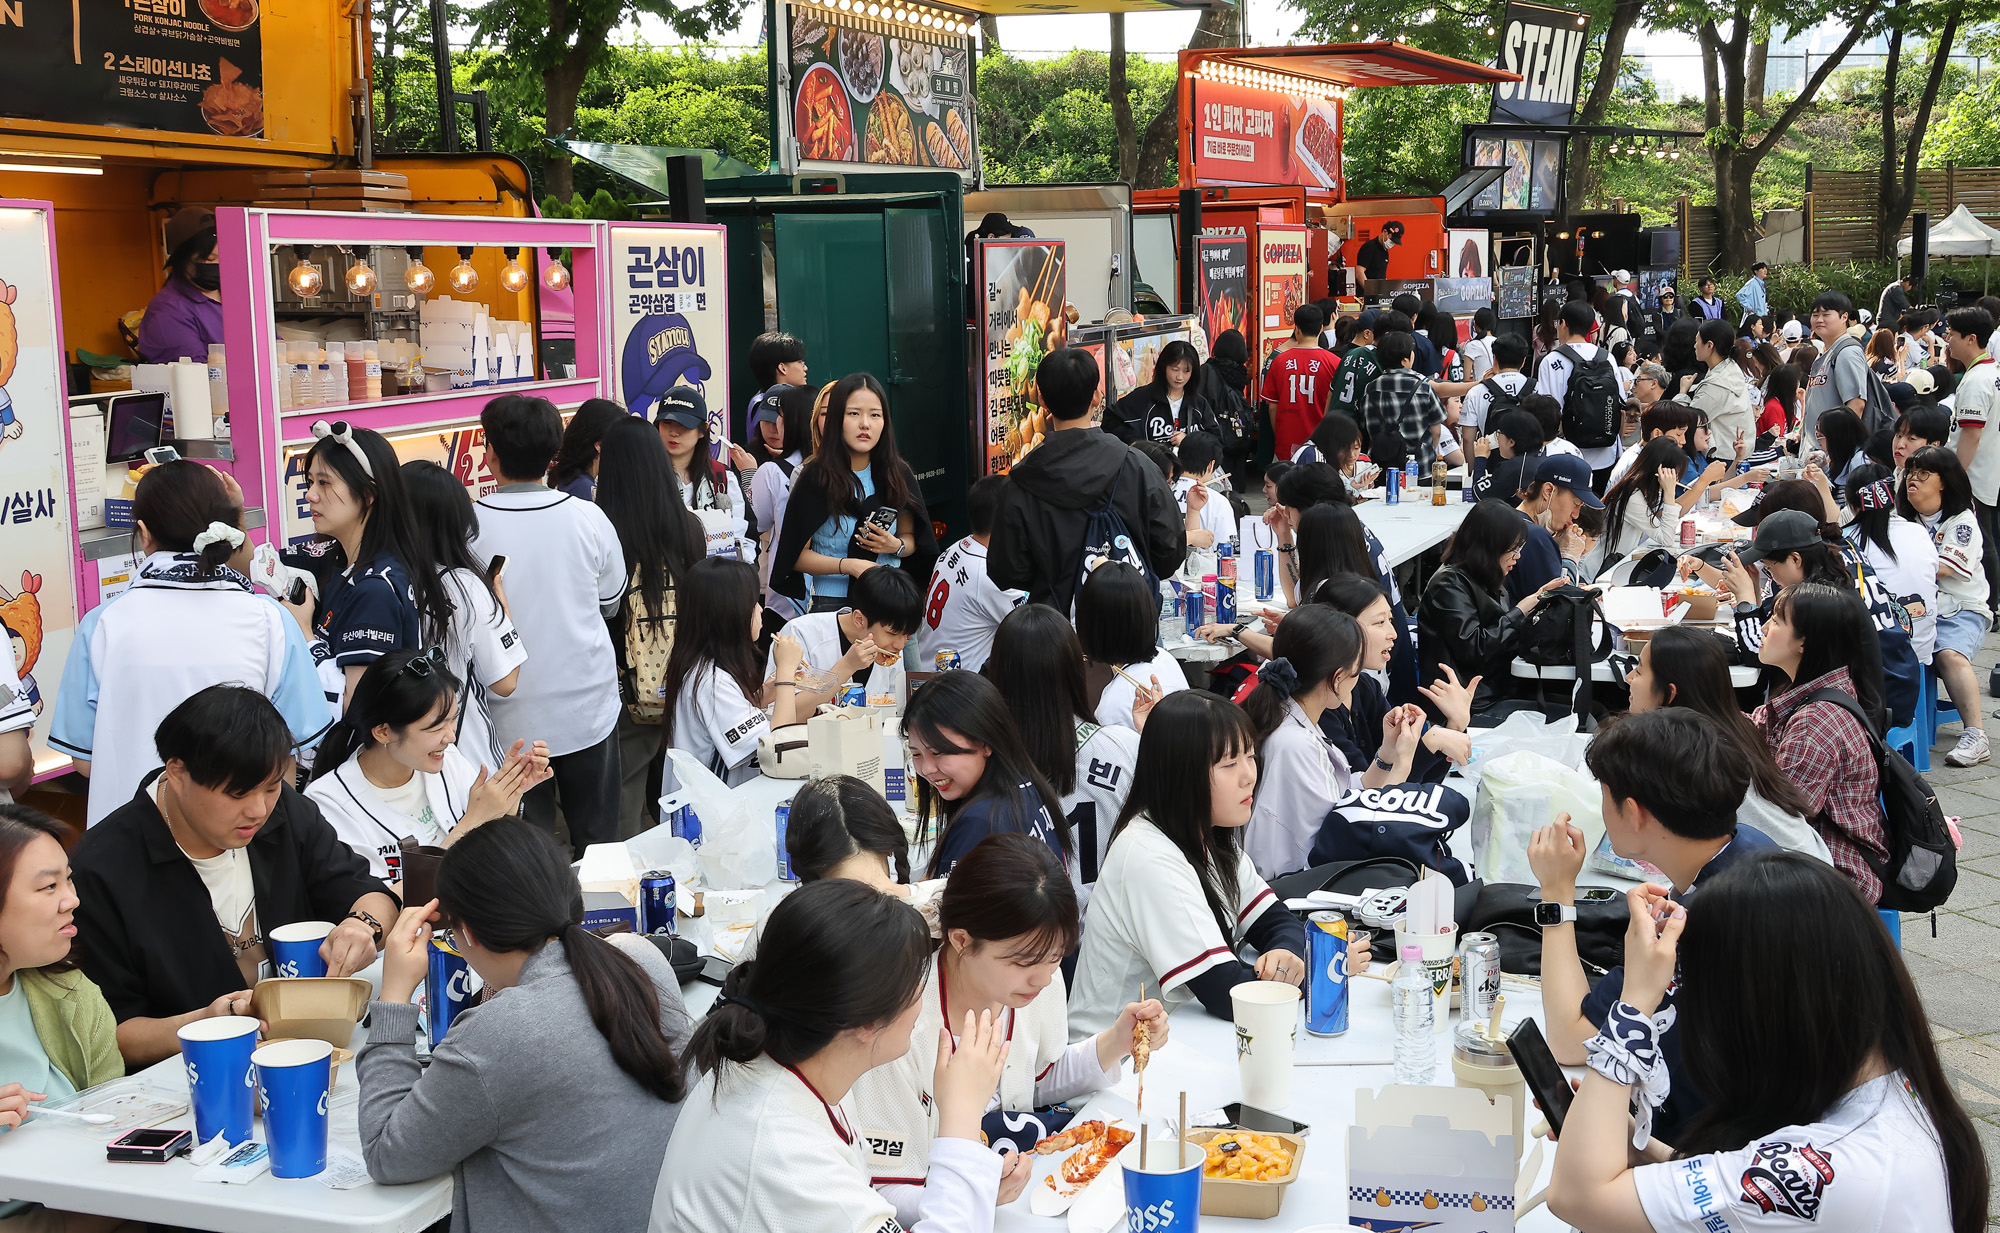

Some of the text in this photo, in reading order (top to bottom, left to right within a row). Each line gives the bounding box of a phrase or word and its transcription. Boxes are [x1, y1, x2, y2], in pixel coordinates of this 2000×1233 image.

[133, 12, 210, 32] PORK KONJAC NOODLE
[103, 51, 212, 81] 2 스테이션나쵸
[1499, 19, 1585, 105] STEAK
[118, 75, 148, 87] 새우튀김
[148, 80, 158, 88] or
[119, 87, 188, 103] 크림소스 or 살사소스
[1203, 102, 1274, 139] 1인 피자 고피자
[1263, 242, 1303, 264] GOPIZZA
[627, 246, 705, 288] 곤삼이
[1460, 284, 1489, 302] GOPIZZA
[989, 309, 1018, 331] 거리에서
[989, 339, 1012, 361] 만나는
[1550, 359, 1564, 372] 박
[989, 367, 1012, 389] 따뜻함
[1288, 374, 1316, 404] 14
[663, 396, 695, 409] Avenue
[990, 399, 998, 418] 김
[462, 453, 475, 487] 2
[341, 628, 395, 644] 두산에너빌리티
[737, 712, 766, 735] 동문건설
[1087, 757, 1122, 793] 빈
[1802, 1148, 1831, 1176] DOOSAN
[1757, 1141, 1822, 1221] Bears
[1745, 1182, 1765, 1205] SEOUL
